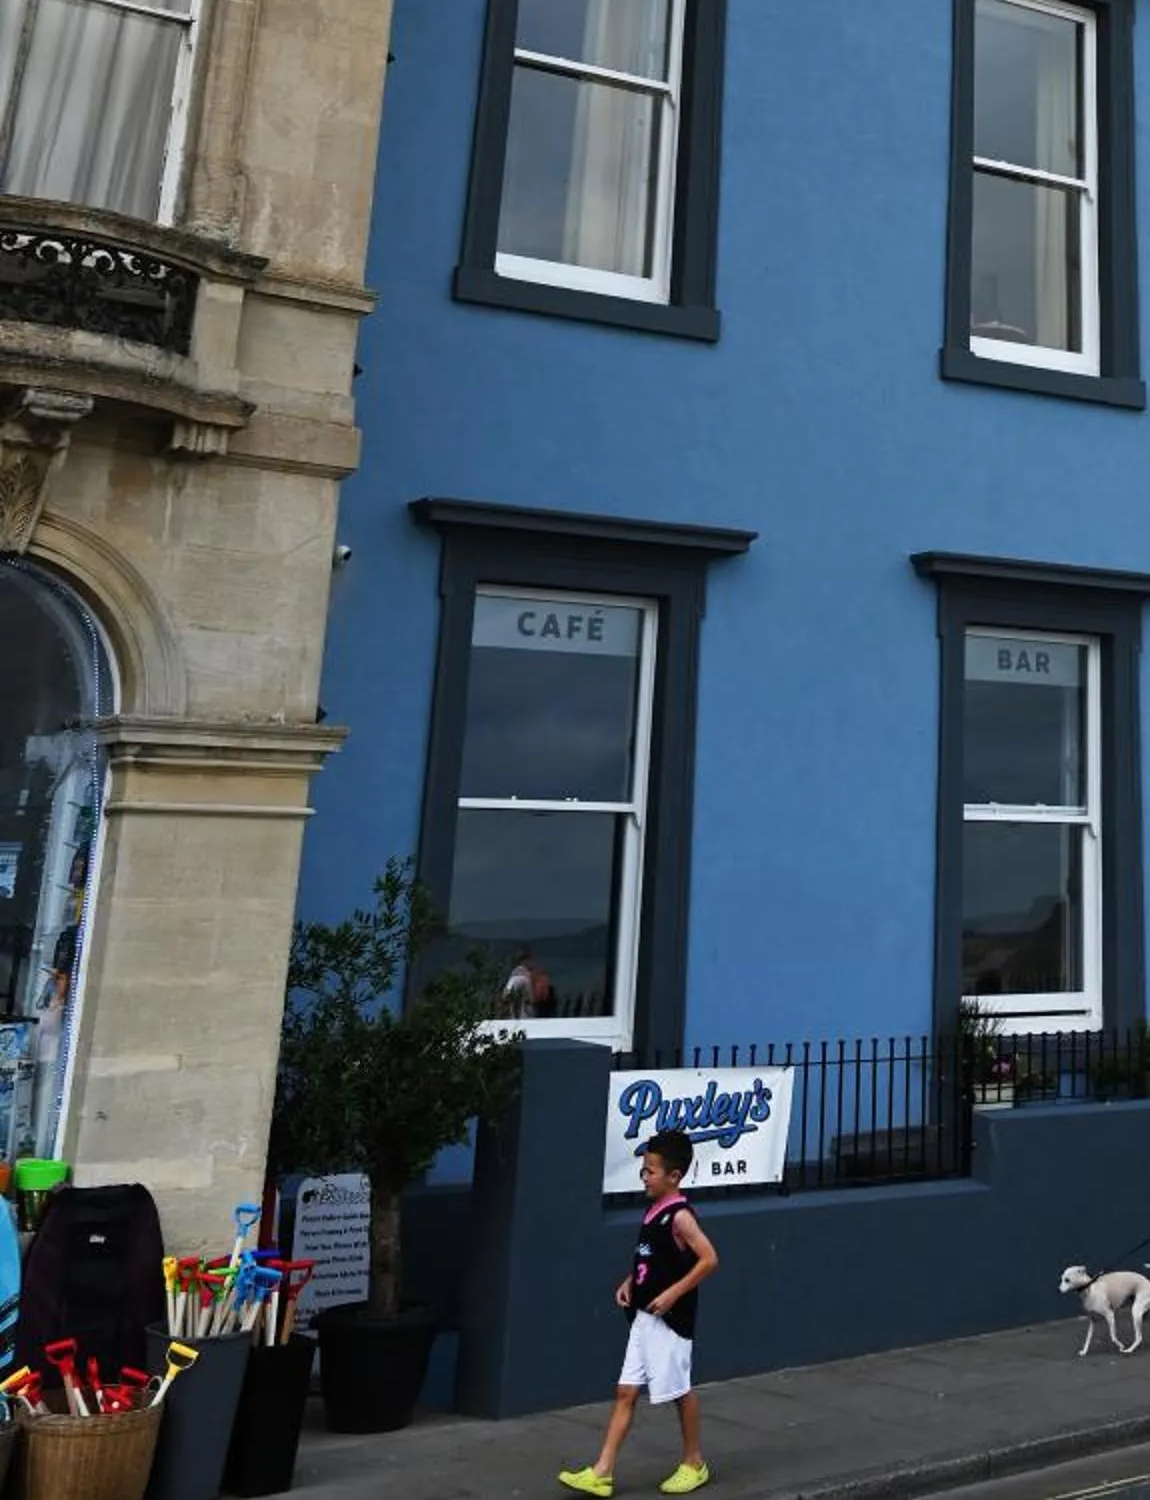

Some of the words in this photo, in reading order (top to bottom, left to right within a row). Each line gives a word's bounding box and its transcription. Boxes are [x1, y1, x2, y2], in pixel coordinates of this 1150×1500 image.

[517, 609, 605, 641] CAFÉ
[997, 648, 1051, 674] BAR
[618, 1077, 773, 1150] Puxley's
[711, 1160, 748, 1176] BAR
